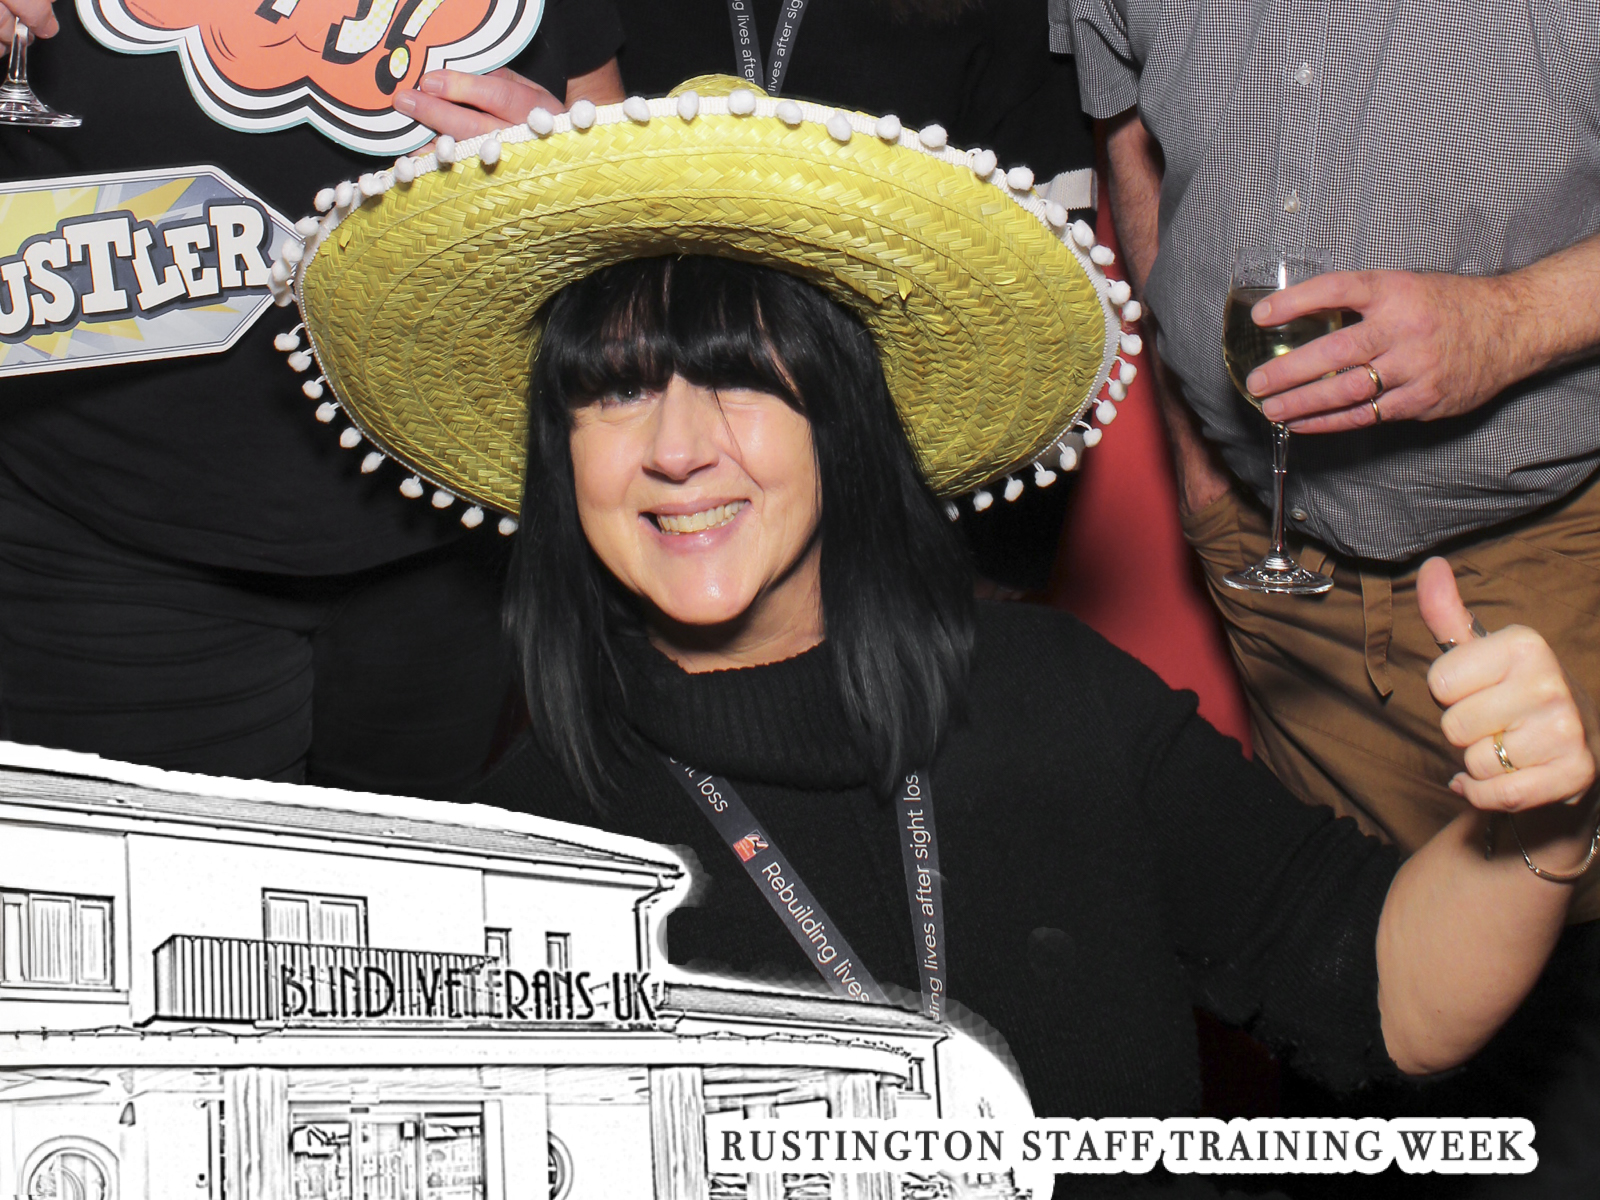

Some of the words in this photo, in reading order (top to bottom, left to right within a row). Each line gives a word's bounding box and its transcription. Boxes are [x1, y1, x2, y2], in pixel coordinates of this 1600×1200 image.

[737, 14, 750, 45] lives
[768, 61, 783, 91] lives
[776, 22, 793, 57] after
[0, 204, 272, 335] USTLER
[697, 775, 728, 812] loss
[903, 770, 921, 801] los
[907, 808, 932, 860] sight
[761, 861, 838, 965] Rebuilding
[916, 864, 935, 917] after
[924, 922, 939, 970] lives
